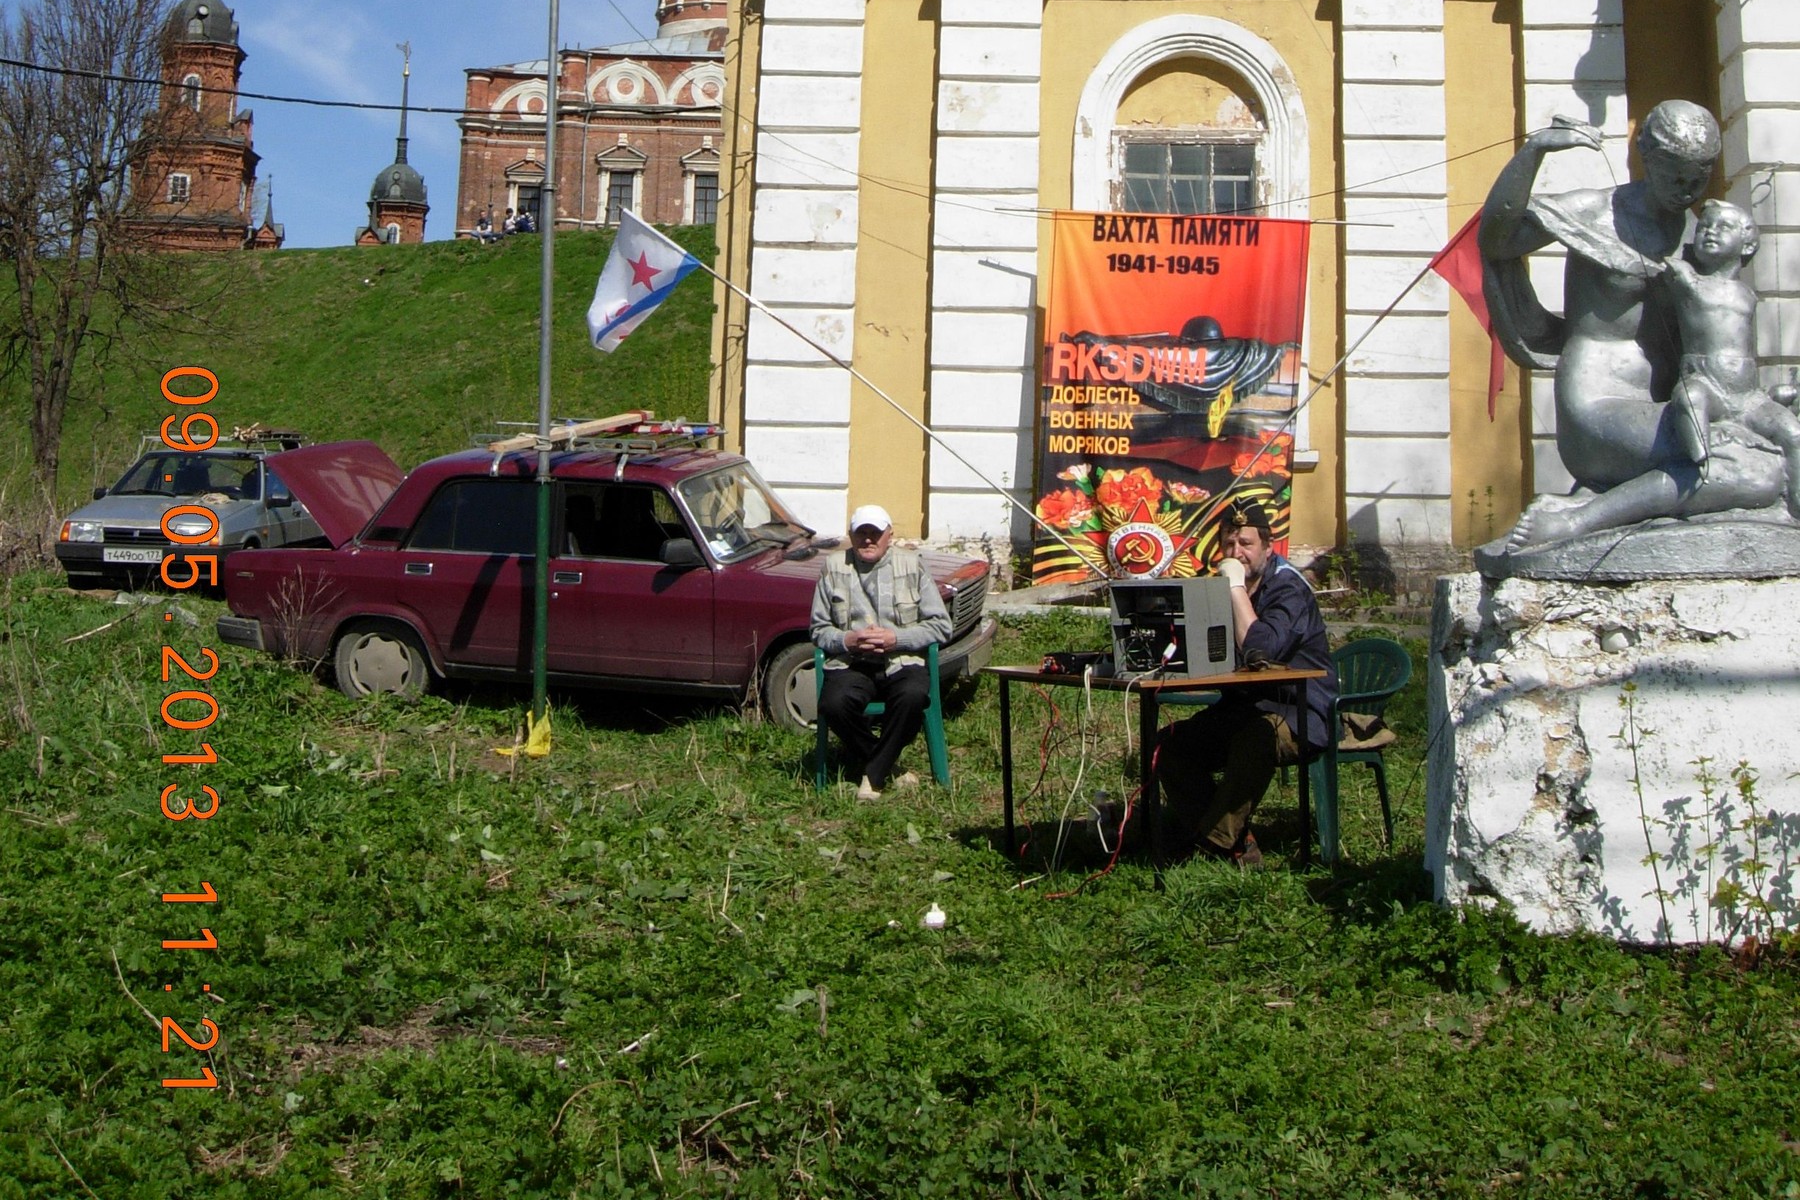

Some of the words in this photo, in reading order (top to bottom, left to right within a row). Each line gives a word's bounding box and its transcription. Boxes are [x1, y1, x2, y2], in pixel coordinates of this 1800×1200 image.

[1093, 214, 1159, 244] ВАХТА
[1170, 217, 1261, 247] ПАМЯТИ
[1106, 252, 1220, 276] 1941-1945
[1051, 342, 1208, 384] RK3DWM
[1050, 385, 1141, 406] ДОБЛЕСТЬ
[1049, 410, 1135, 430] ВОЕННЫХ
[1049, 434, 1131, 456] МОРЯКОВ
